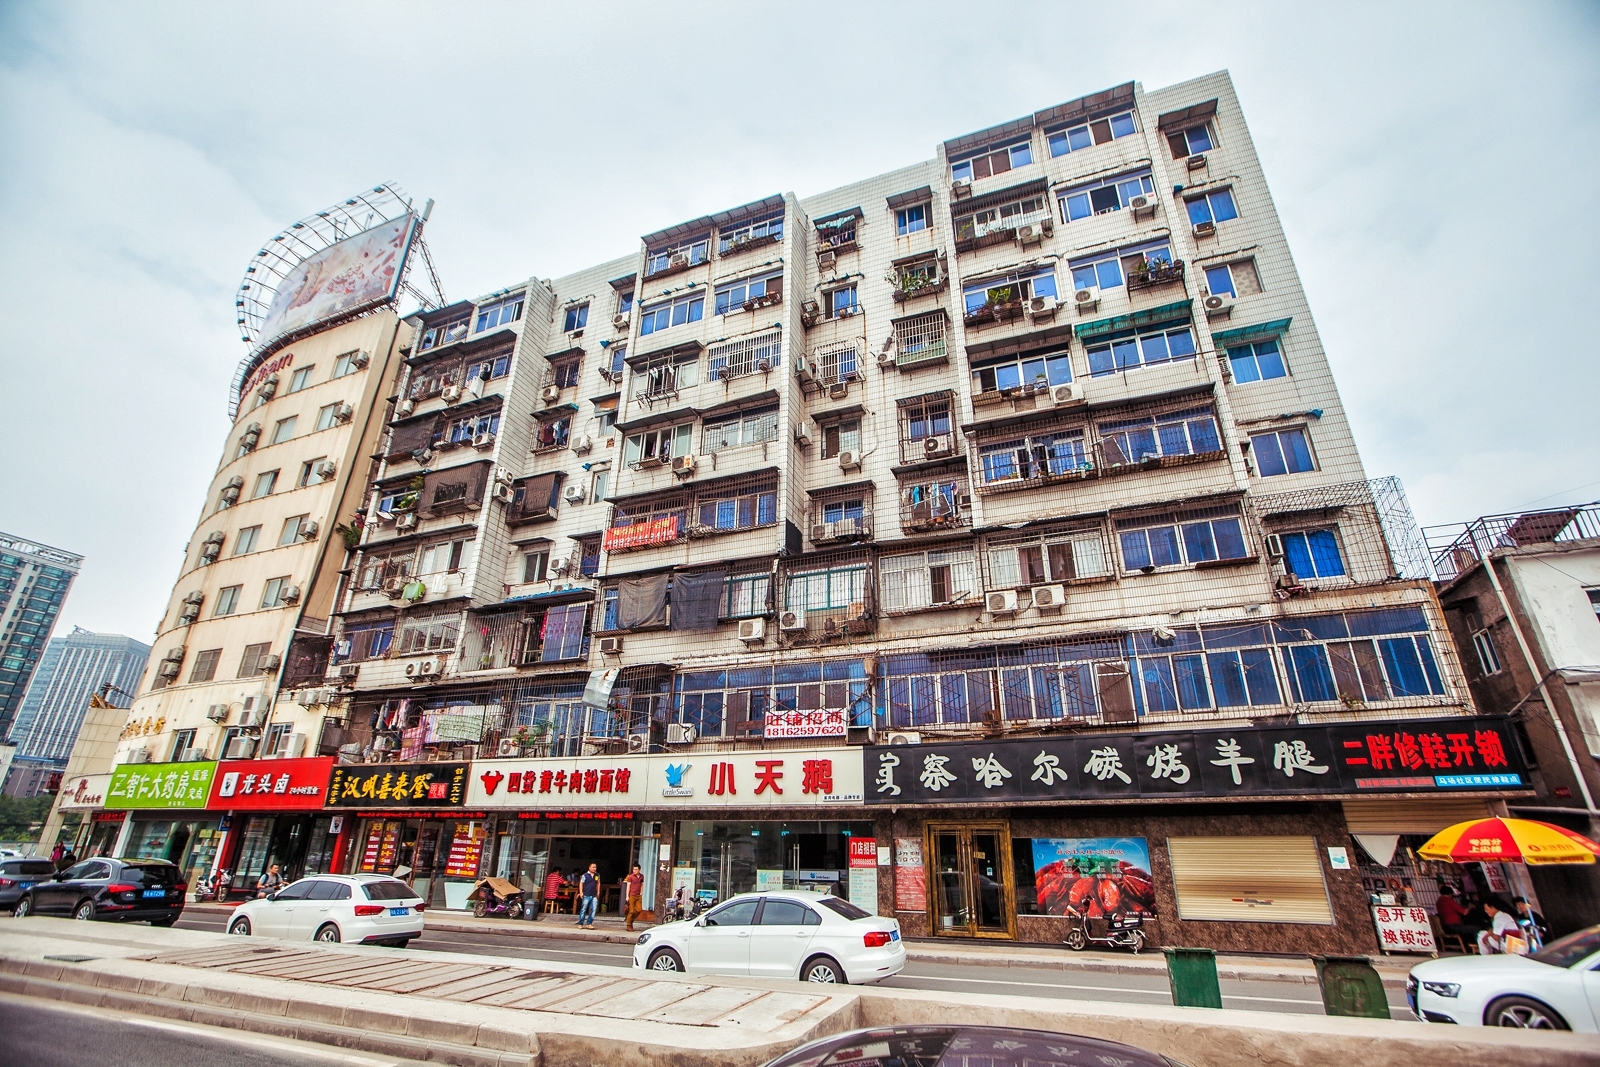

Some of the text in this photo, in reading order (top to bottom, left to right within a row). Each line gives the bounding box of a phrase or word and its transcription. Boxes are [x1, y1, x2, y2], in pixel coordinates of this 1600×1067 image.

[766, 711, 844, 727] 旺铺招商
[766, 725, 844, 736] 18162597620
[1343, 730, 1508, 770] 二胖修鞋开锁
[707, 759, 833, 795] 小天鹅
[920, 738, 1329, 792] 察哈尔碳烤羊腿
[240, 773, 290, 794] 光头卤
[329, 769, 343, 804] 中华老字号
[341, 771, 431, 801] 汉明喜来登
[851, 841, 876, 855] 门店招租
[1485, 862, 1507, 891] 拉链
[1377, 907, 1427, 923] 急开锁
[1382, 929, 1432, 946] 换锁芯
